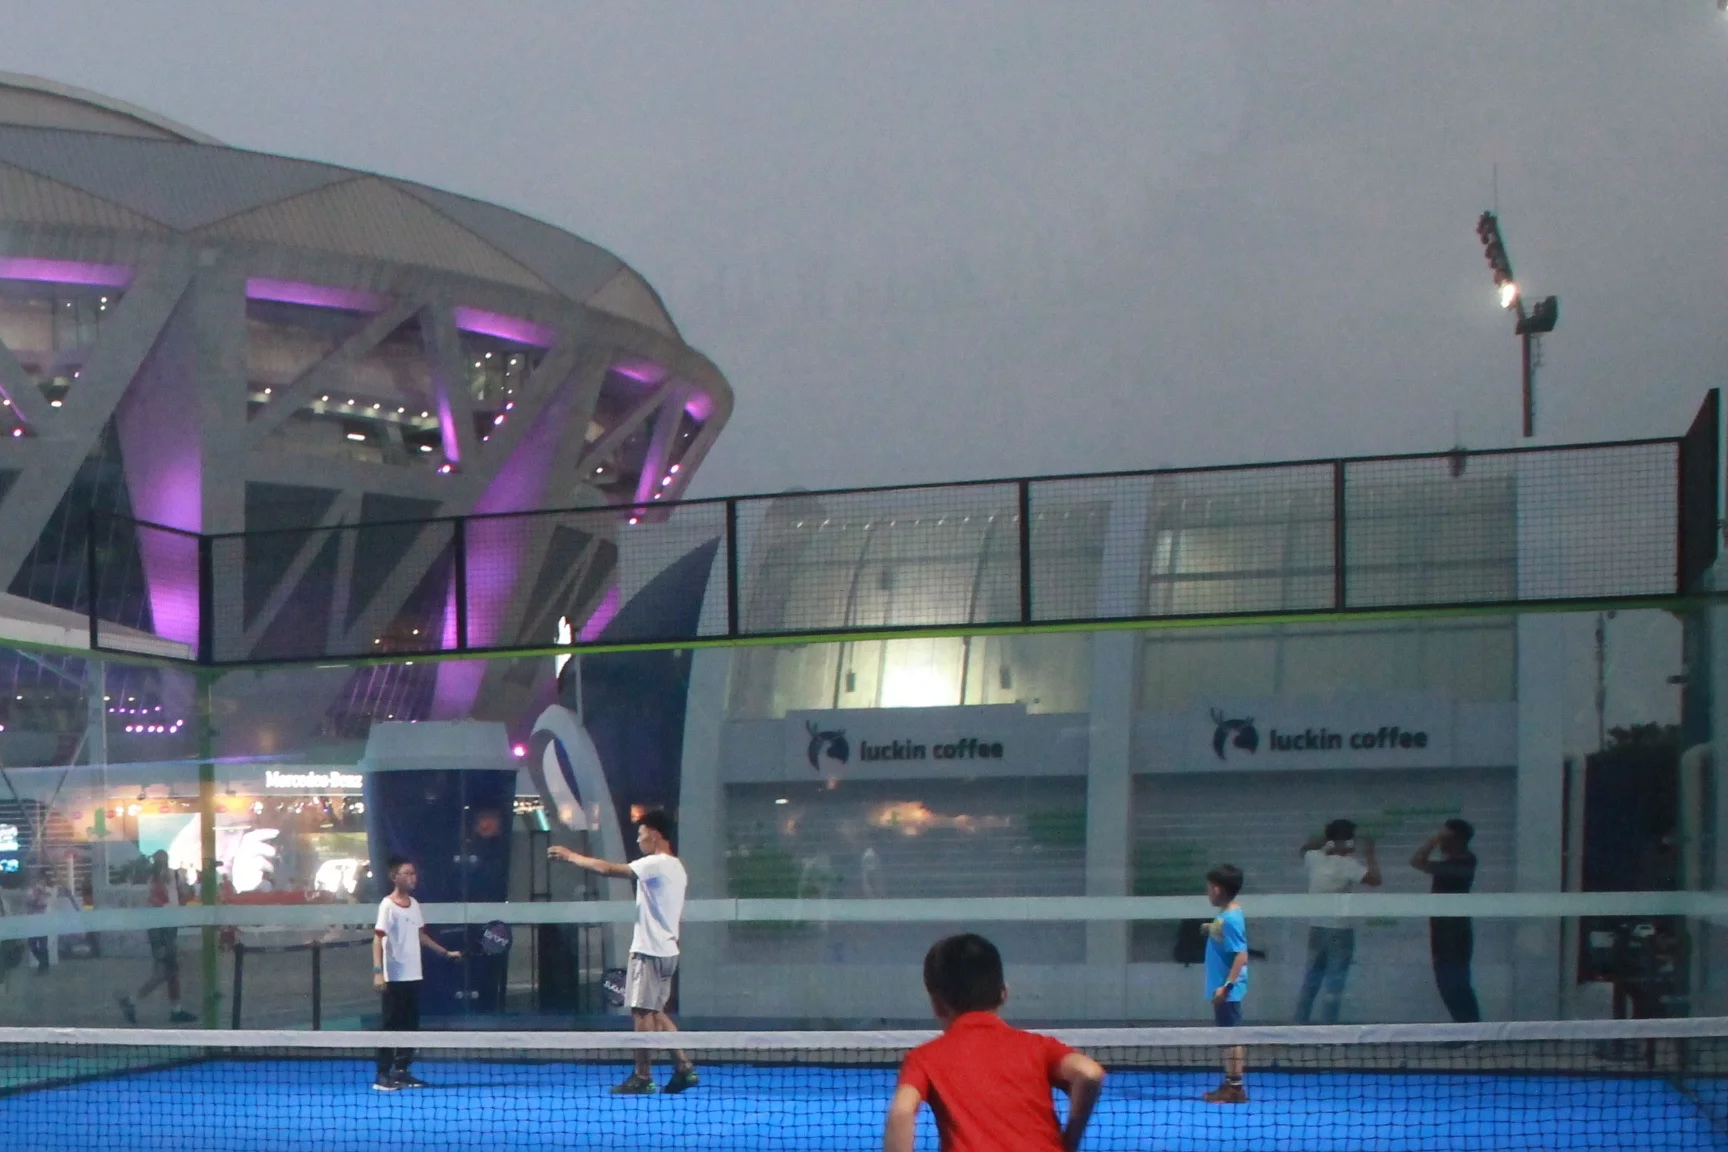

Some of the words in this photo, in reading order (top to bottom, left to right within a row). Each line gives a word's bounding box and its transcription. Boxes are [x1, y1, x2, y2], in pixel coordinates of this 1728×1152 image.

[860, 739, 926, 760] luckin
[932, 738, 1004, 760] coffee
[1269, 727, 1342, 750] luckin
[1349, 726, 1428, 749] coffee
[265, 771, 363, 788] Mercedes-Benz
